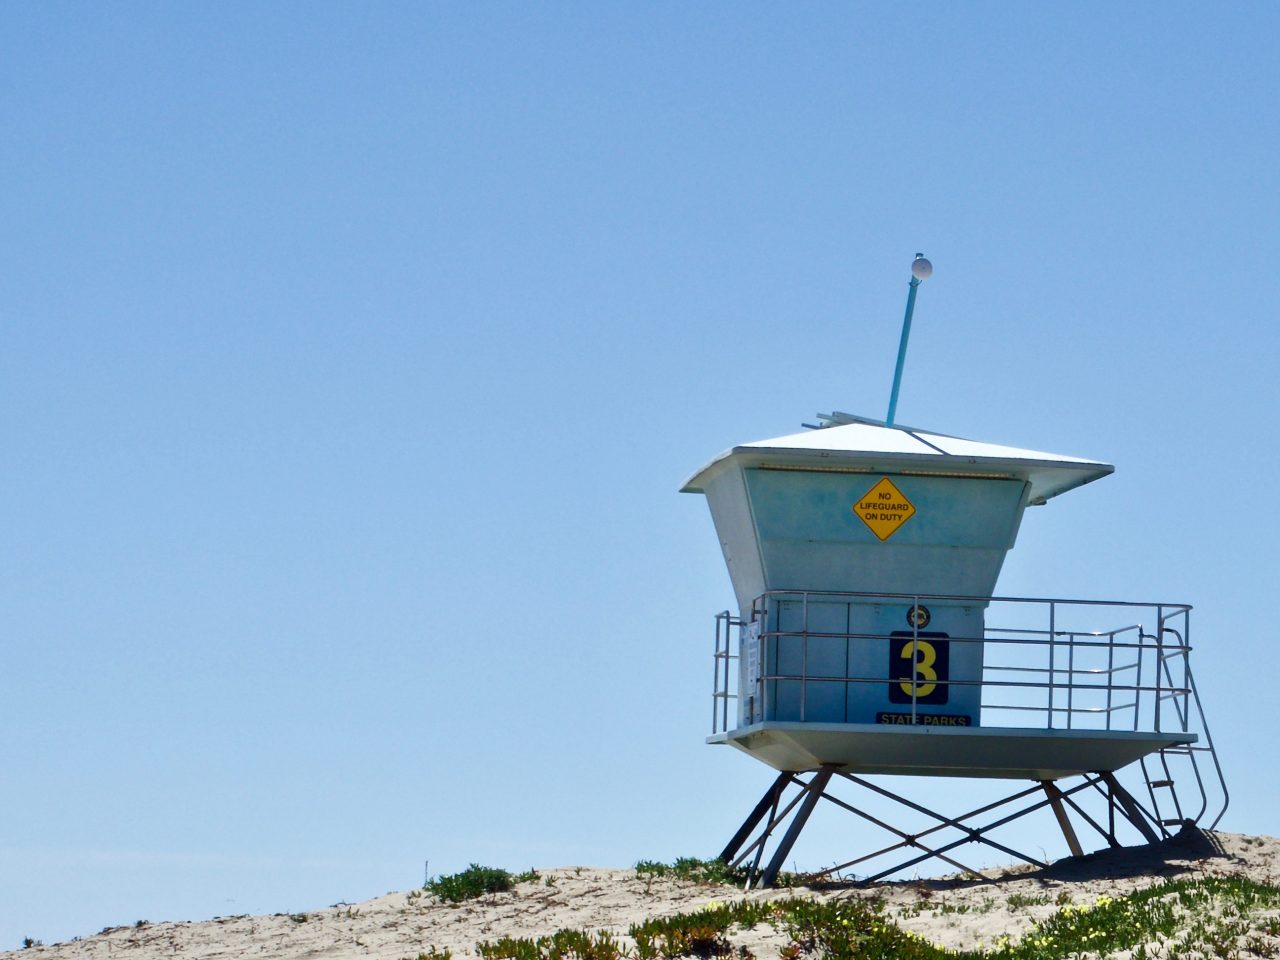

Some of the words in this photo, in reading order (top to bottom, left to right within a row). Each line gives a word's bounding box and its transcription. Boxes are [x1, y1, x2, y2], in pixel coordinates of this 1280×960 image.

[878, 492, 892, 500] NO
[860, 502, 909, 511] LIFEGUARD
[865, 512, 878, 520] ON
[880, 513, 903, 521] DUTY
[899, 640, 938, 698] 3
[923, 715, 966, 727] PARKS
